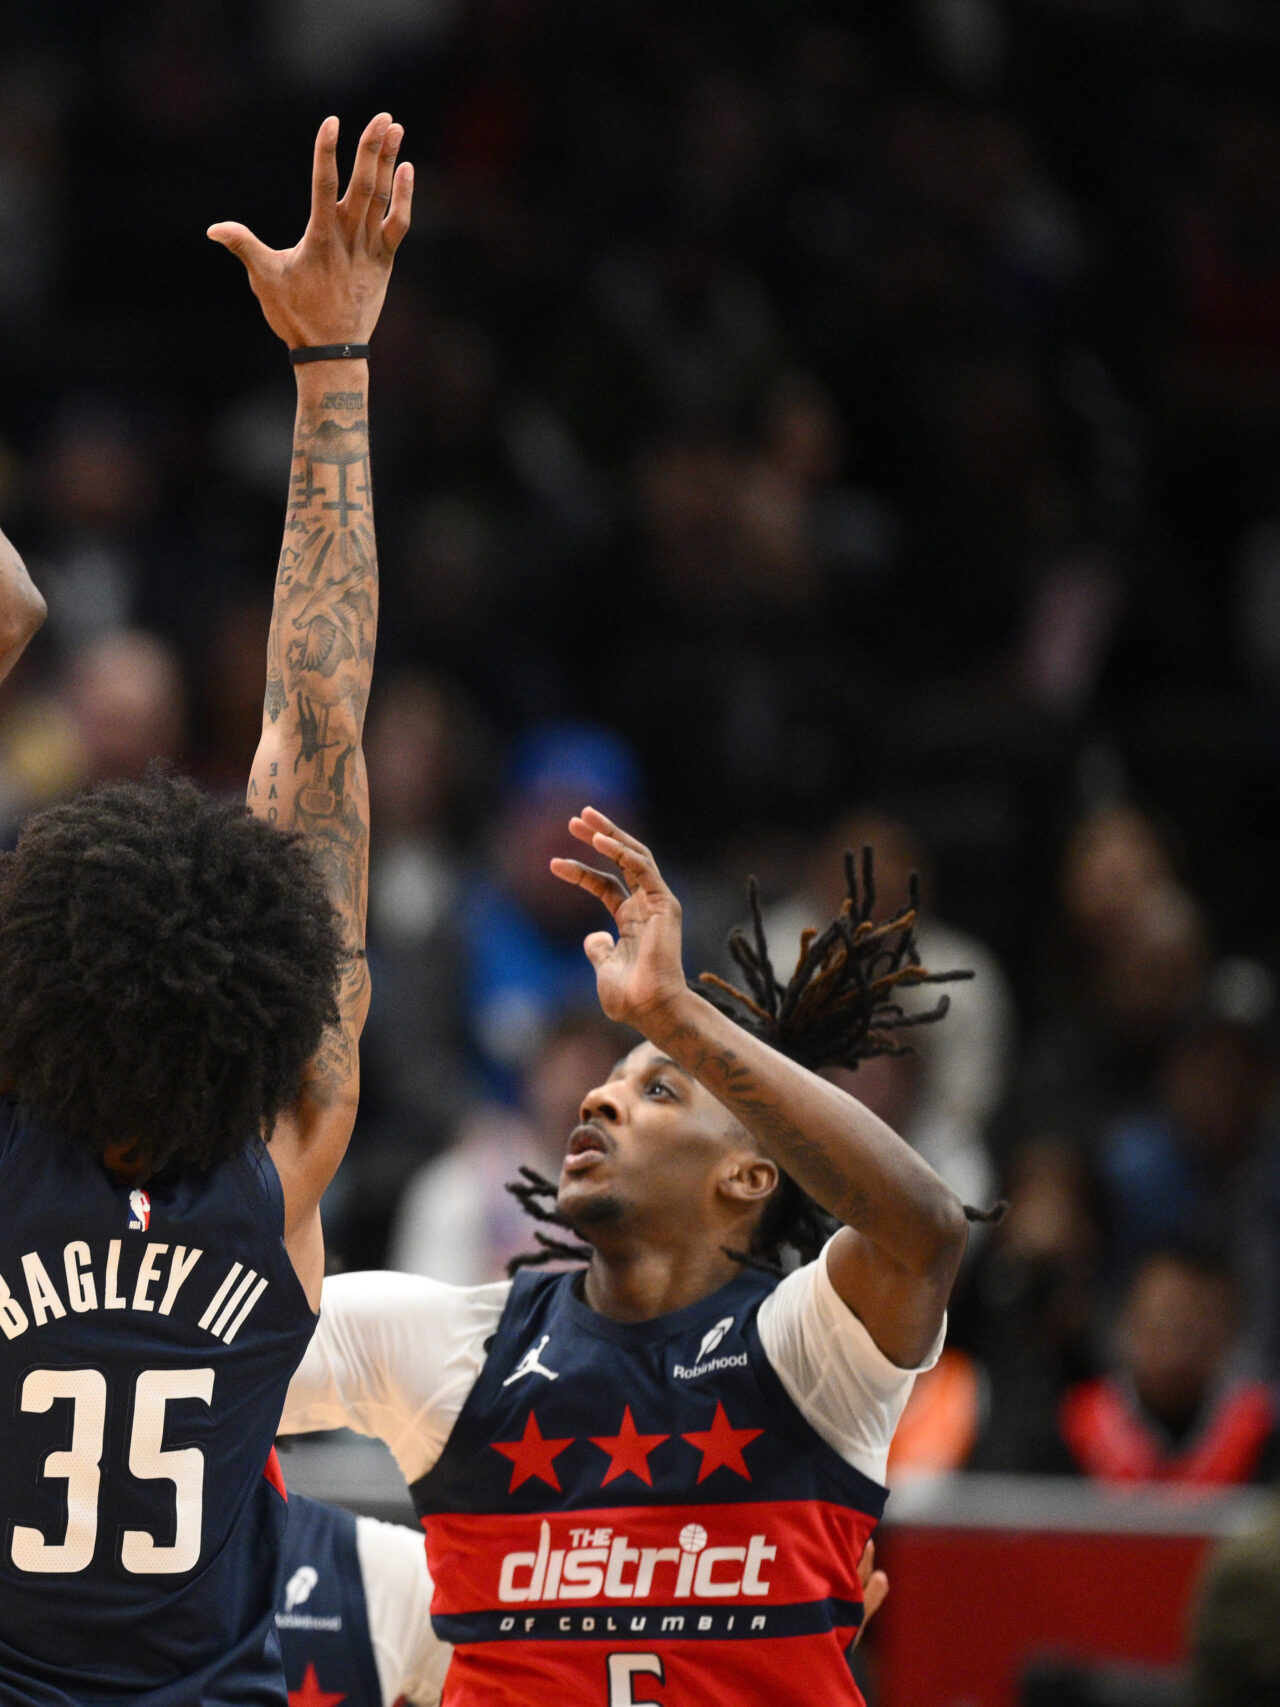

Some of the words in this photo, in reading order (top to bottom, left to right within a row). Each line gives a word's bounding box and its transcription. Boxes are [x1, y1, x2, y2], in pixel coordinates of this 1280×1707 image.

[197, 1261, 270, 1346] III
[673, 1352, 748, 1379] Robinhood
[10, 1367, 216, 1574] 35
[498, 1519, 778, 1602] district
[569, 1528, 613, 1548] THE
[499, 1616, 535, 1632] OF
[558, 1615, 767, 1632] COLUMBIA
